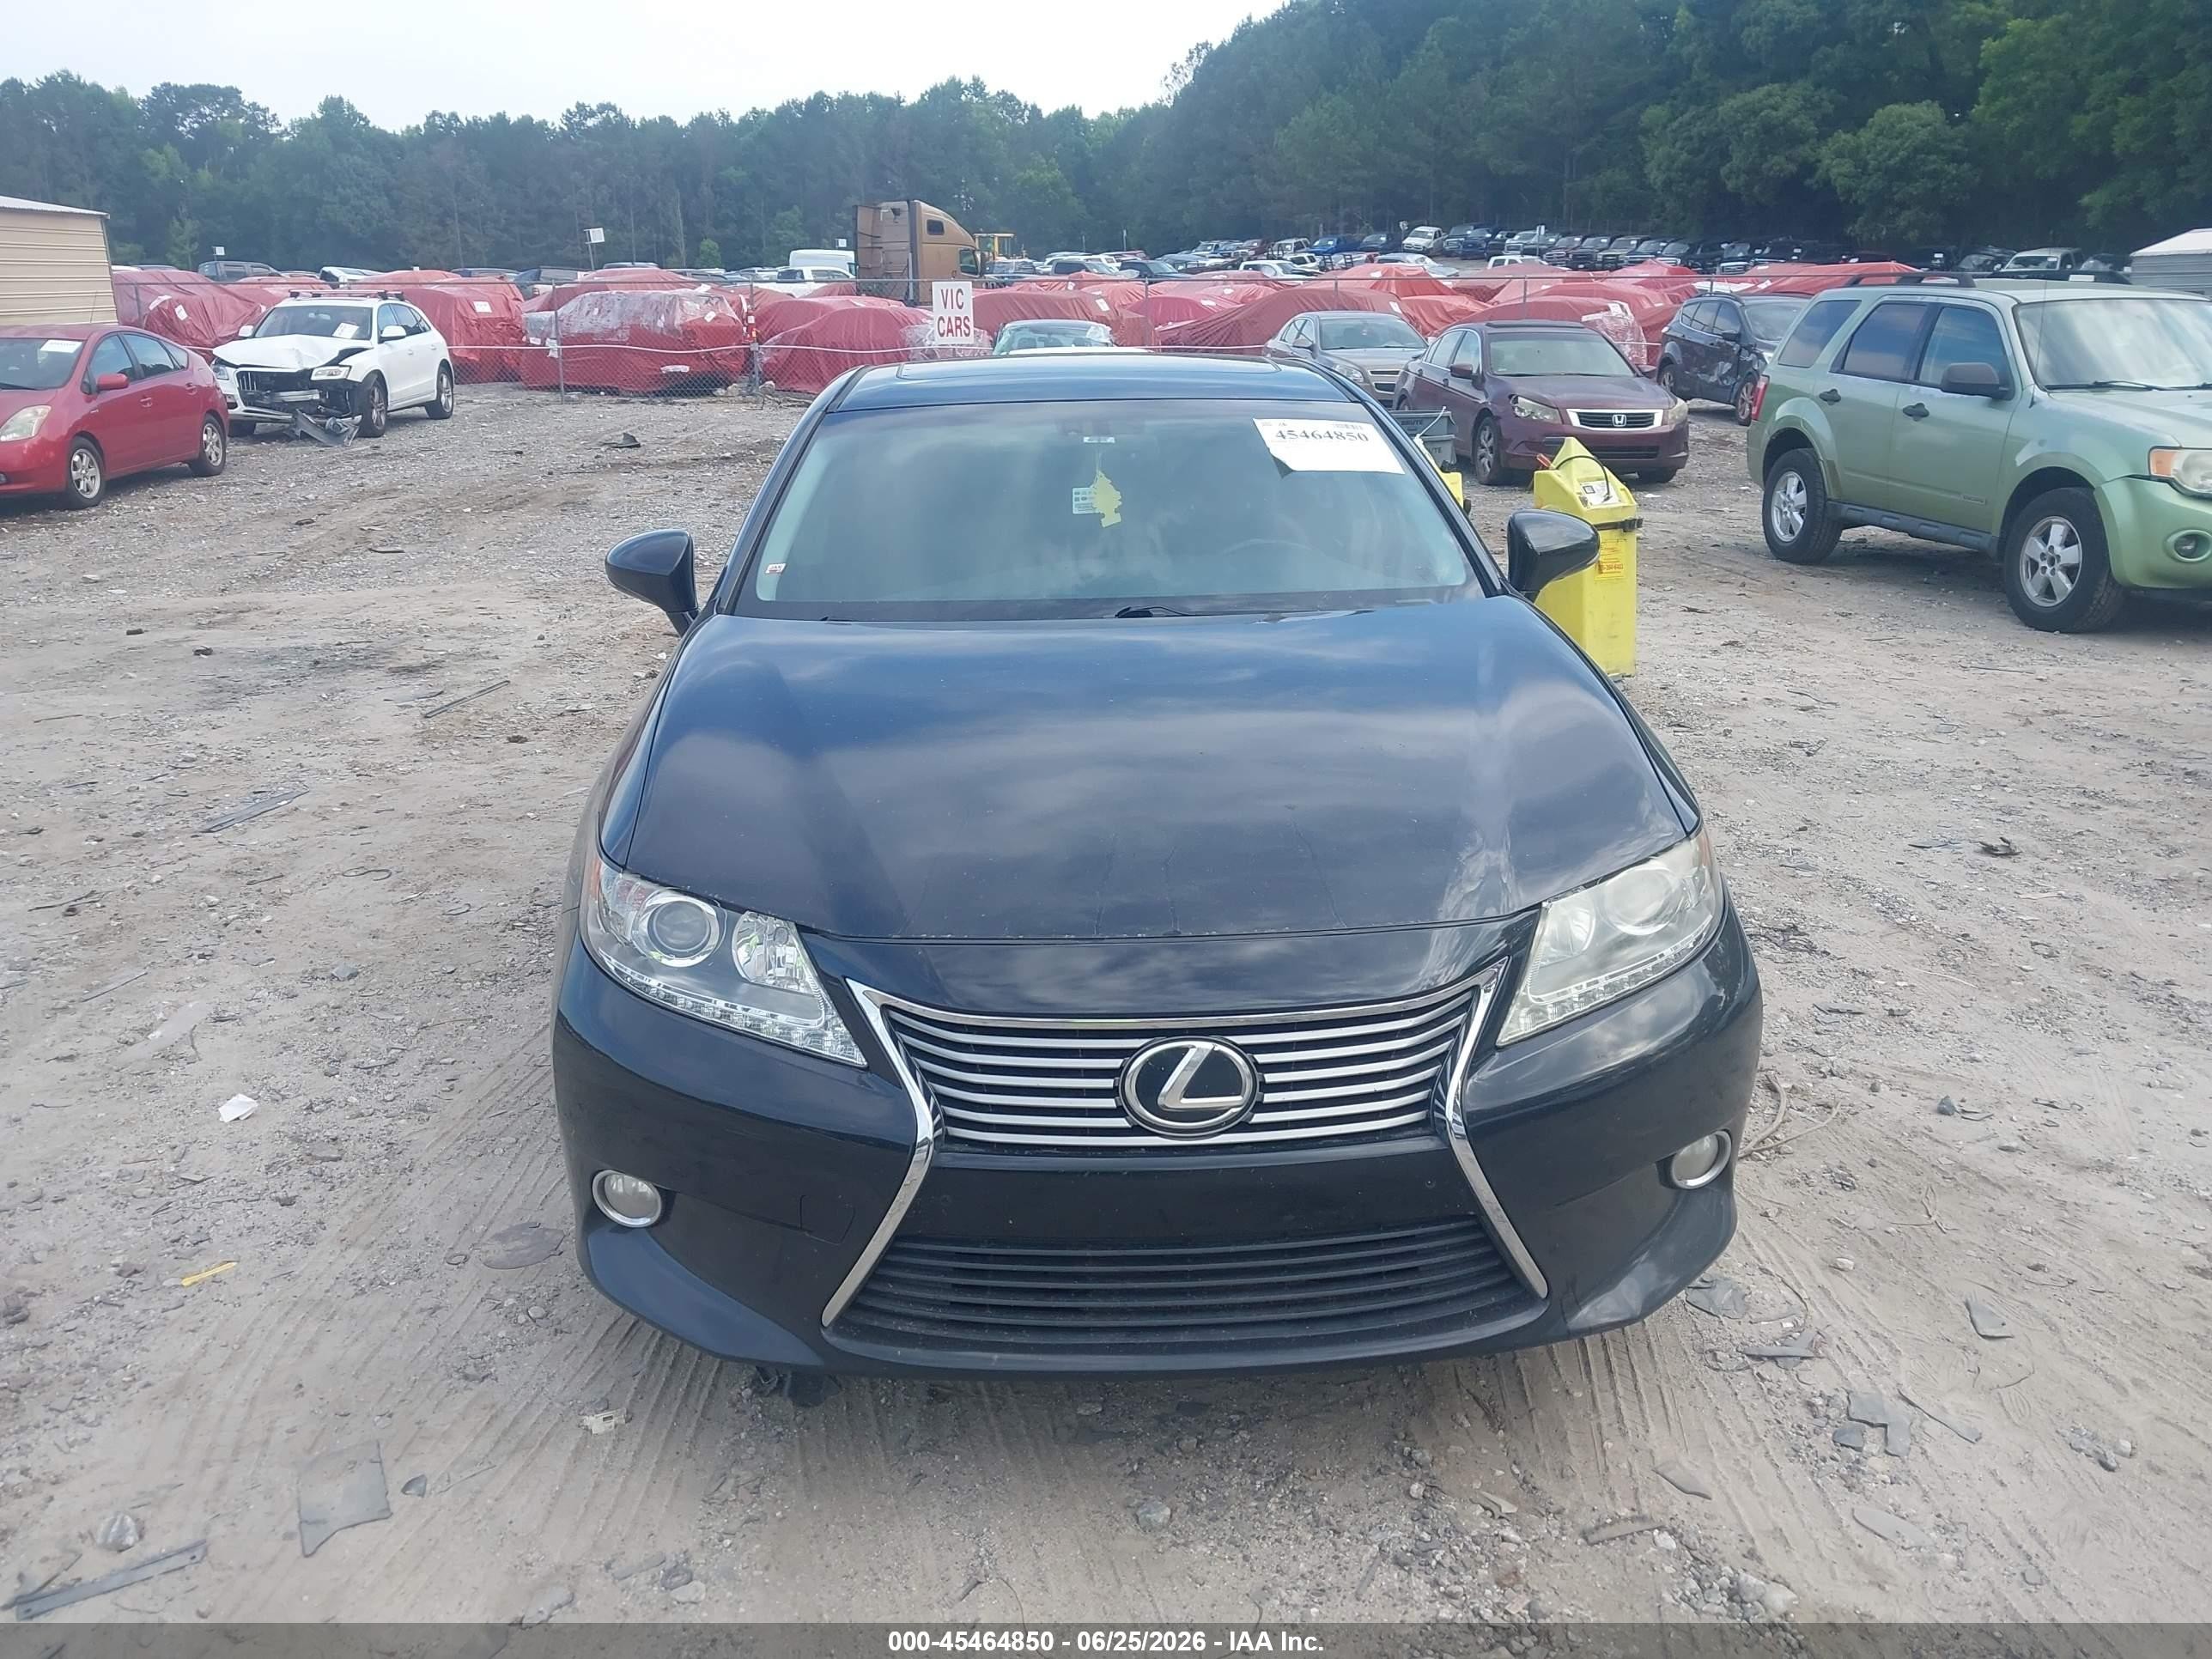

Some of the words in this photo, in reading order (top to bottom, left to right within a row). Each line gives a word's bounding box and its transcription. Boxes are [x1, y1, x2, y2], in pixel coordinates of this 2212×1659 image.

[940, 288, 964, 310] VIC
[937, 315, 971, 337] CARS
[1275, 429, 1369, 441] 45464850
